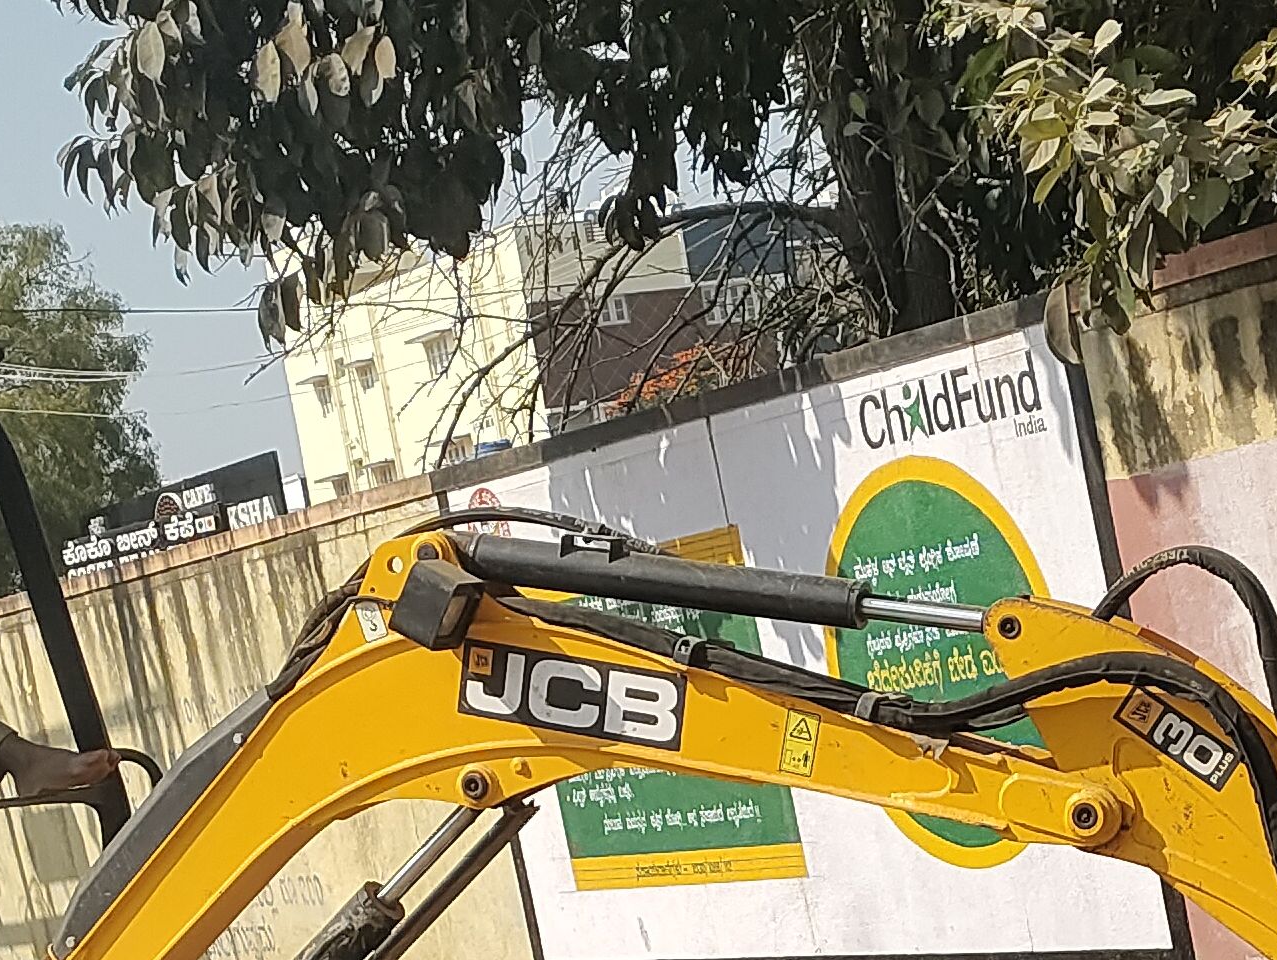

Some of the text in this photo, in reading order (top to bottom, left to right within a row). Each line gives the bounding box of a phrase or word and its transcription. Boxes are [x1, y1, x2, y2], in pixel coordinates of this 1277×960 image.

[859, 350, 1043, 449] ChildFund
[1013, 414, 1048, 438] India
[182, 483, 216, 510] CAFE
[466, 652, 678, 742] JCB
[1152, 712, 1223, 776] 30
[1210, 751, 1235, 785] PLUS
